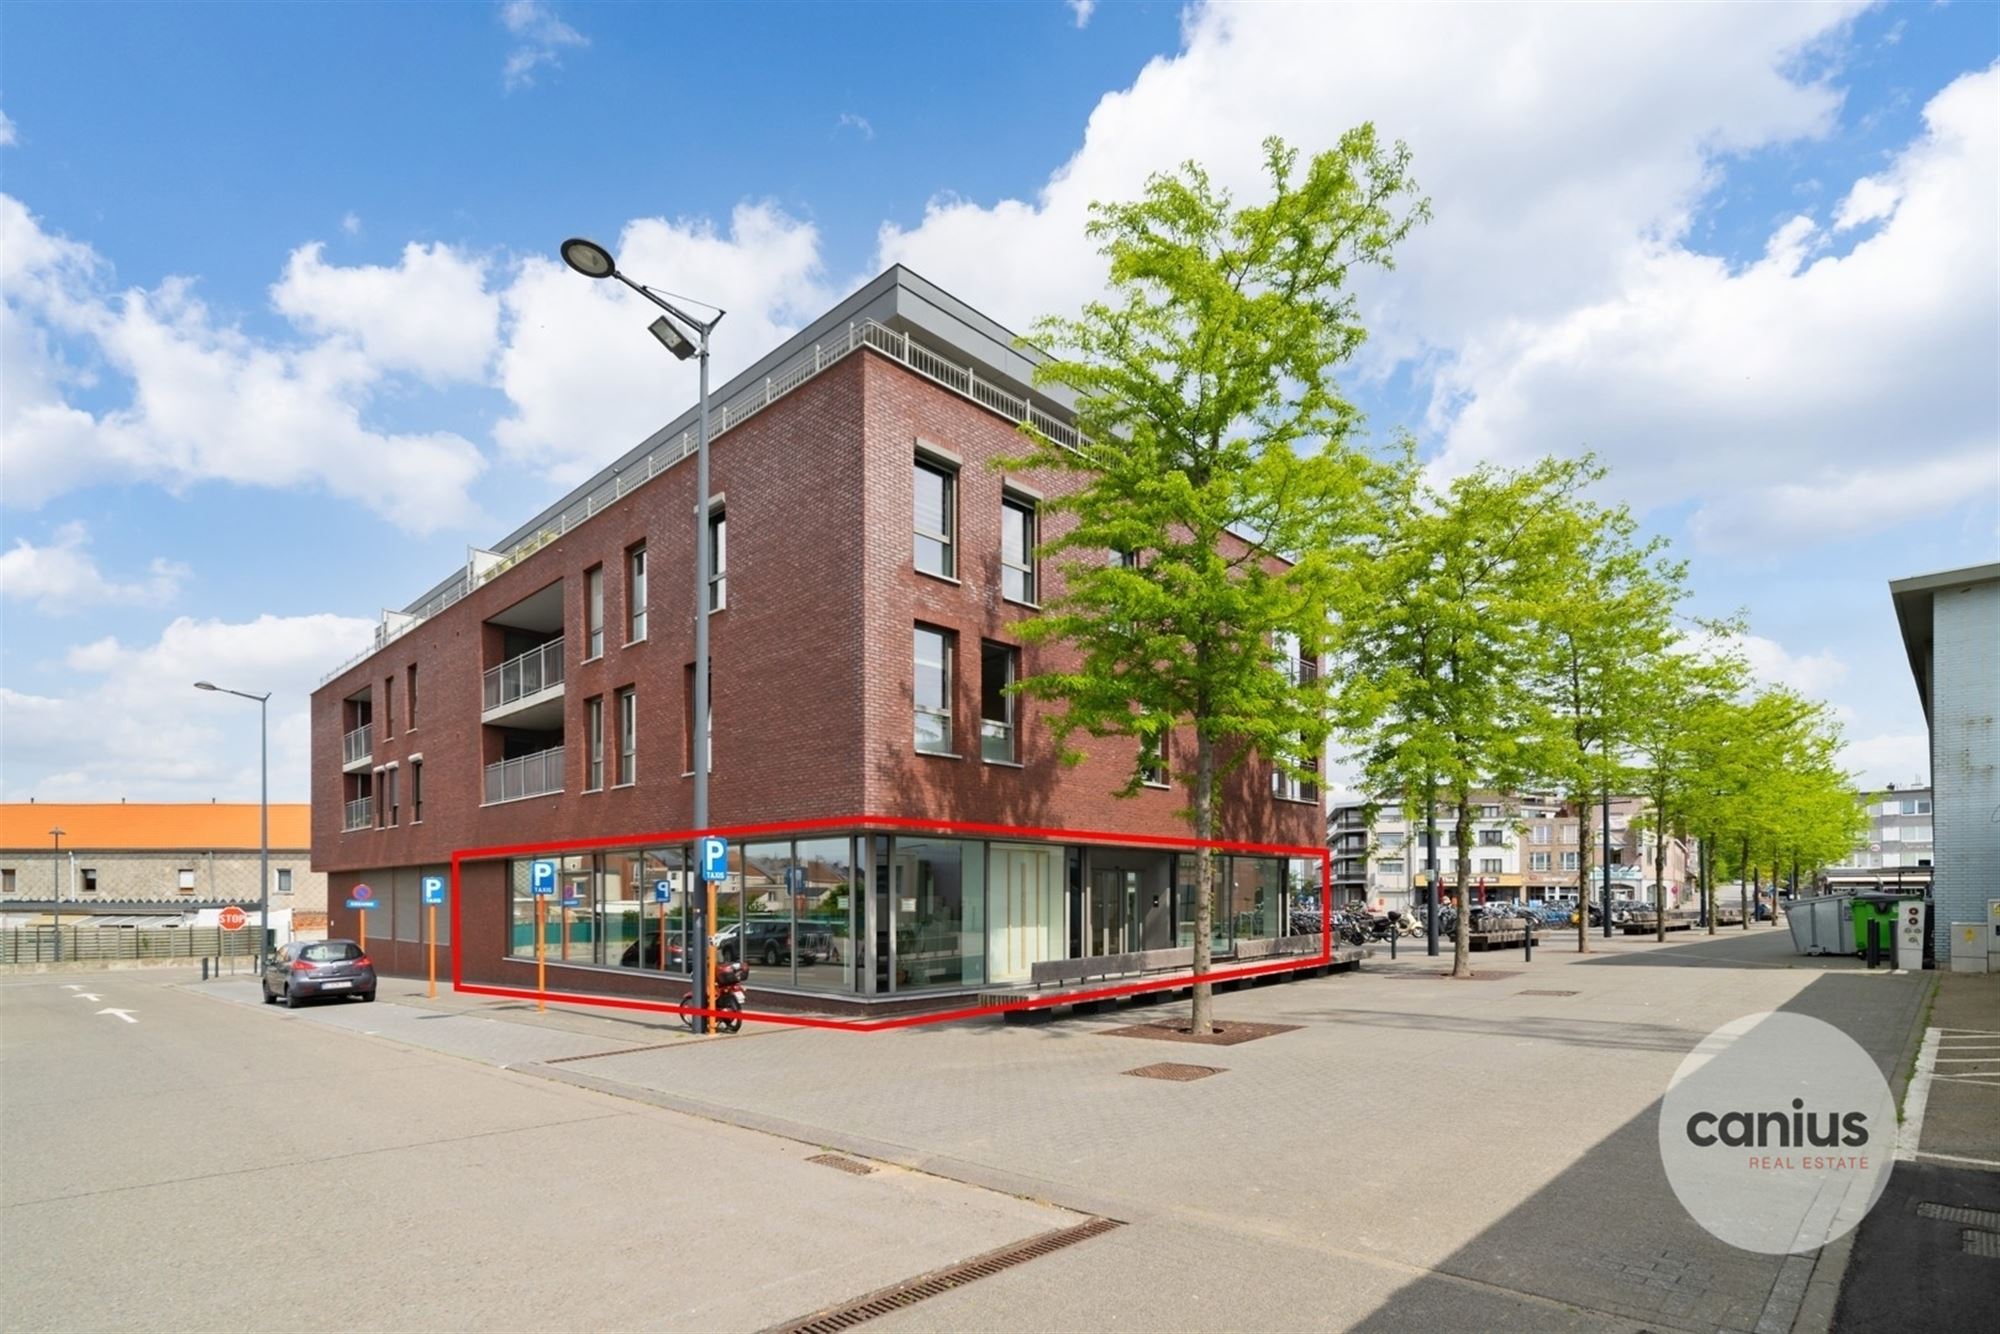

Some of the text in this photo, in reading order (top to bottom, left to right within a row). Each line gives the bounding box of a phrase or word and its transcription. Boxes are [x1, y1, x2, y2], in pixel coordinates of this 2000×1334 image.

[707, 840, 724, 870] P
[534, 863, 551, 886] P
[426, 879, 441, 898] P
[219, 914, 244, 923] STOP
